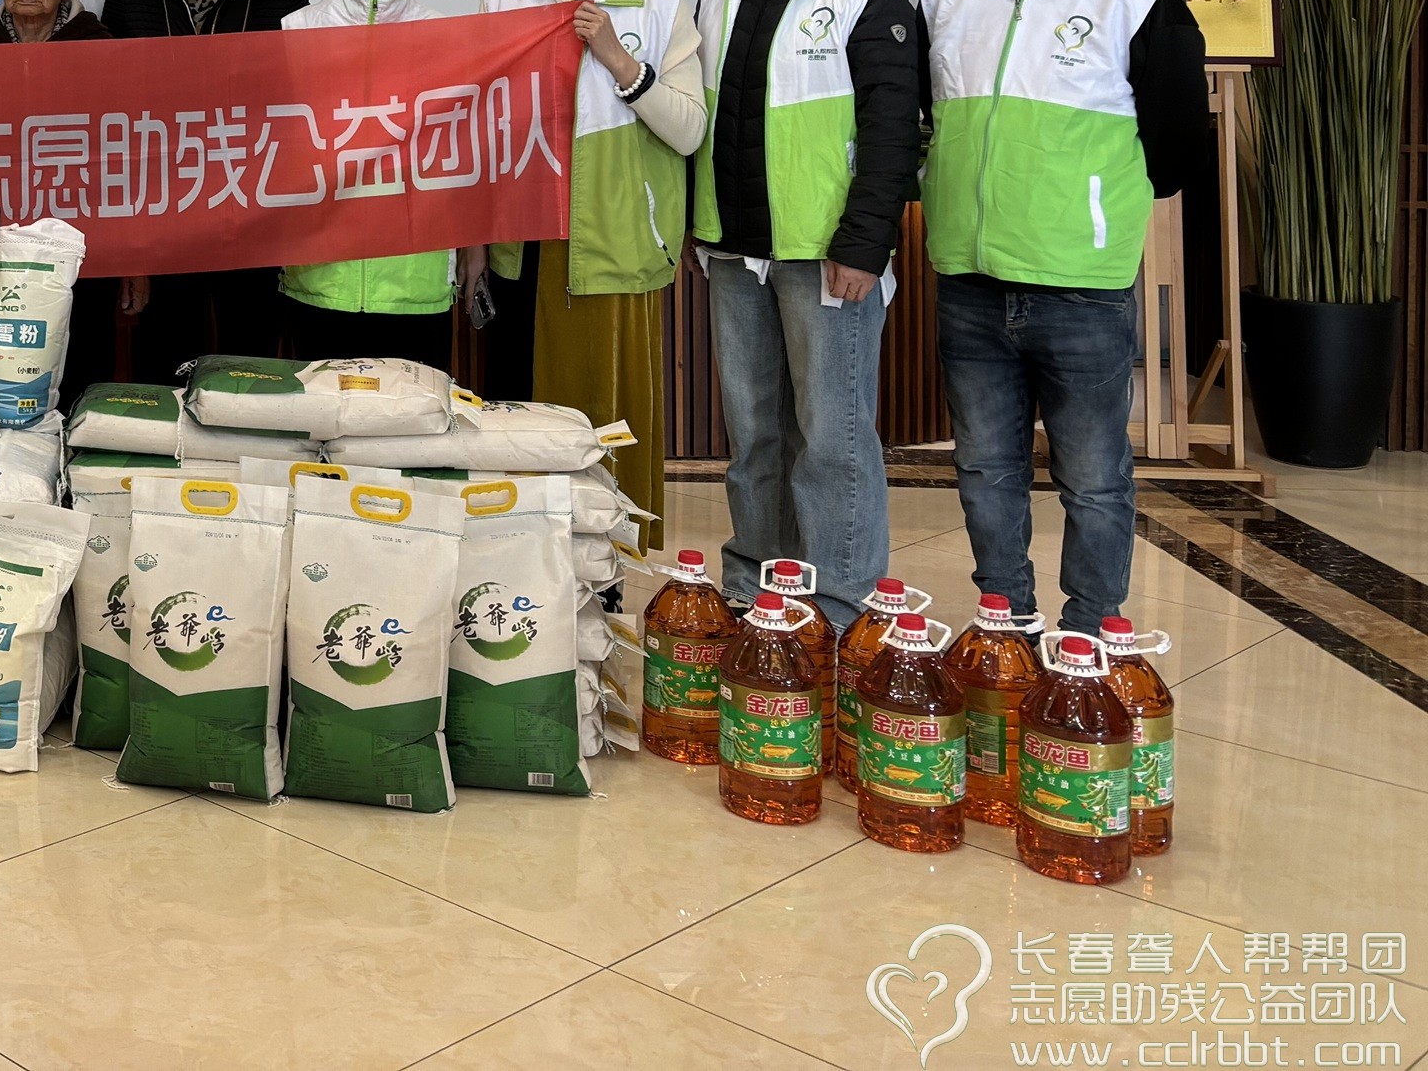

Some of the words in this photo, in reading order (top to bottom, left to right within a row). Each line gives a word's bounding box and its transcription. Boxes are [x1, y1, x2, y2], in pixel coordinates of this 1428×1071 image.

[746, 692, 810, 718] 金龙鱼
[872, 711, 941, 743] 金龙鱼
[1023, 732, 1091, 770] 金龙鱼
